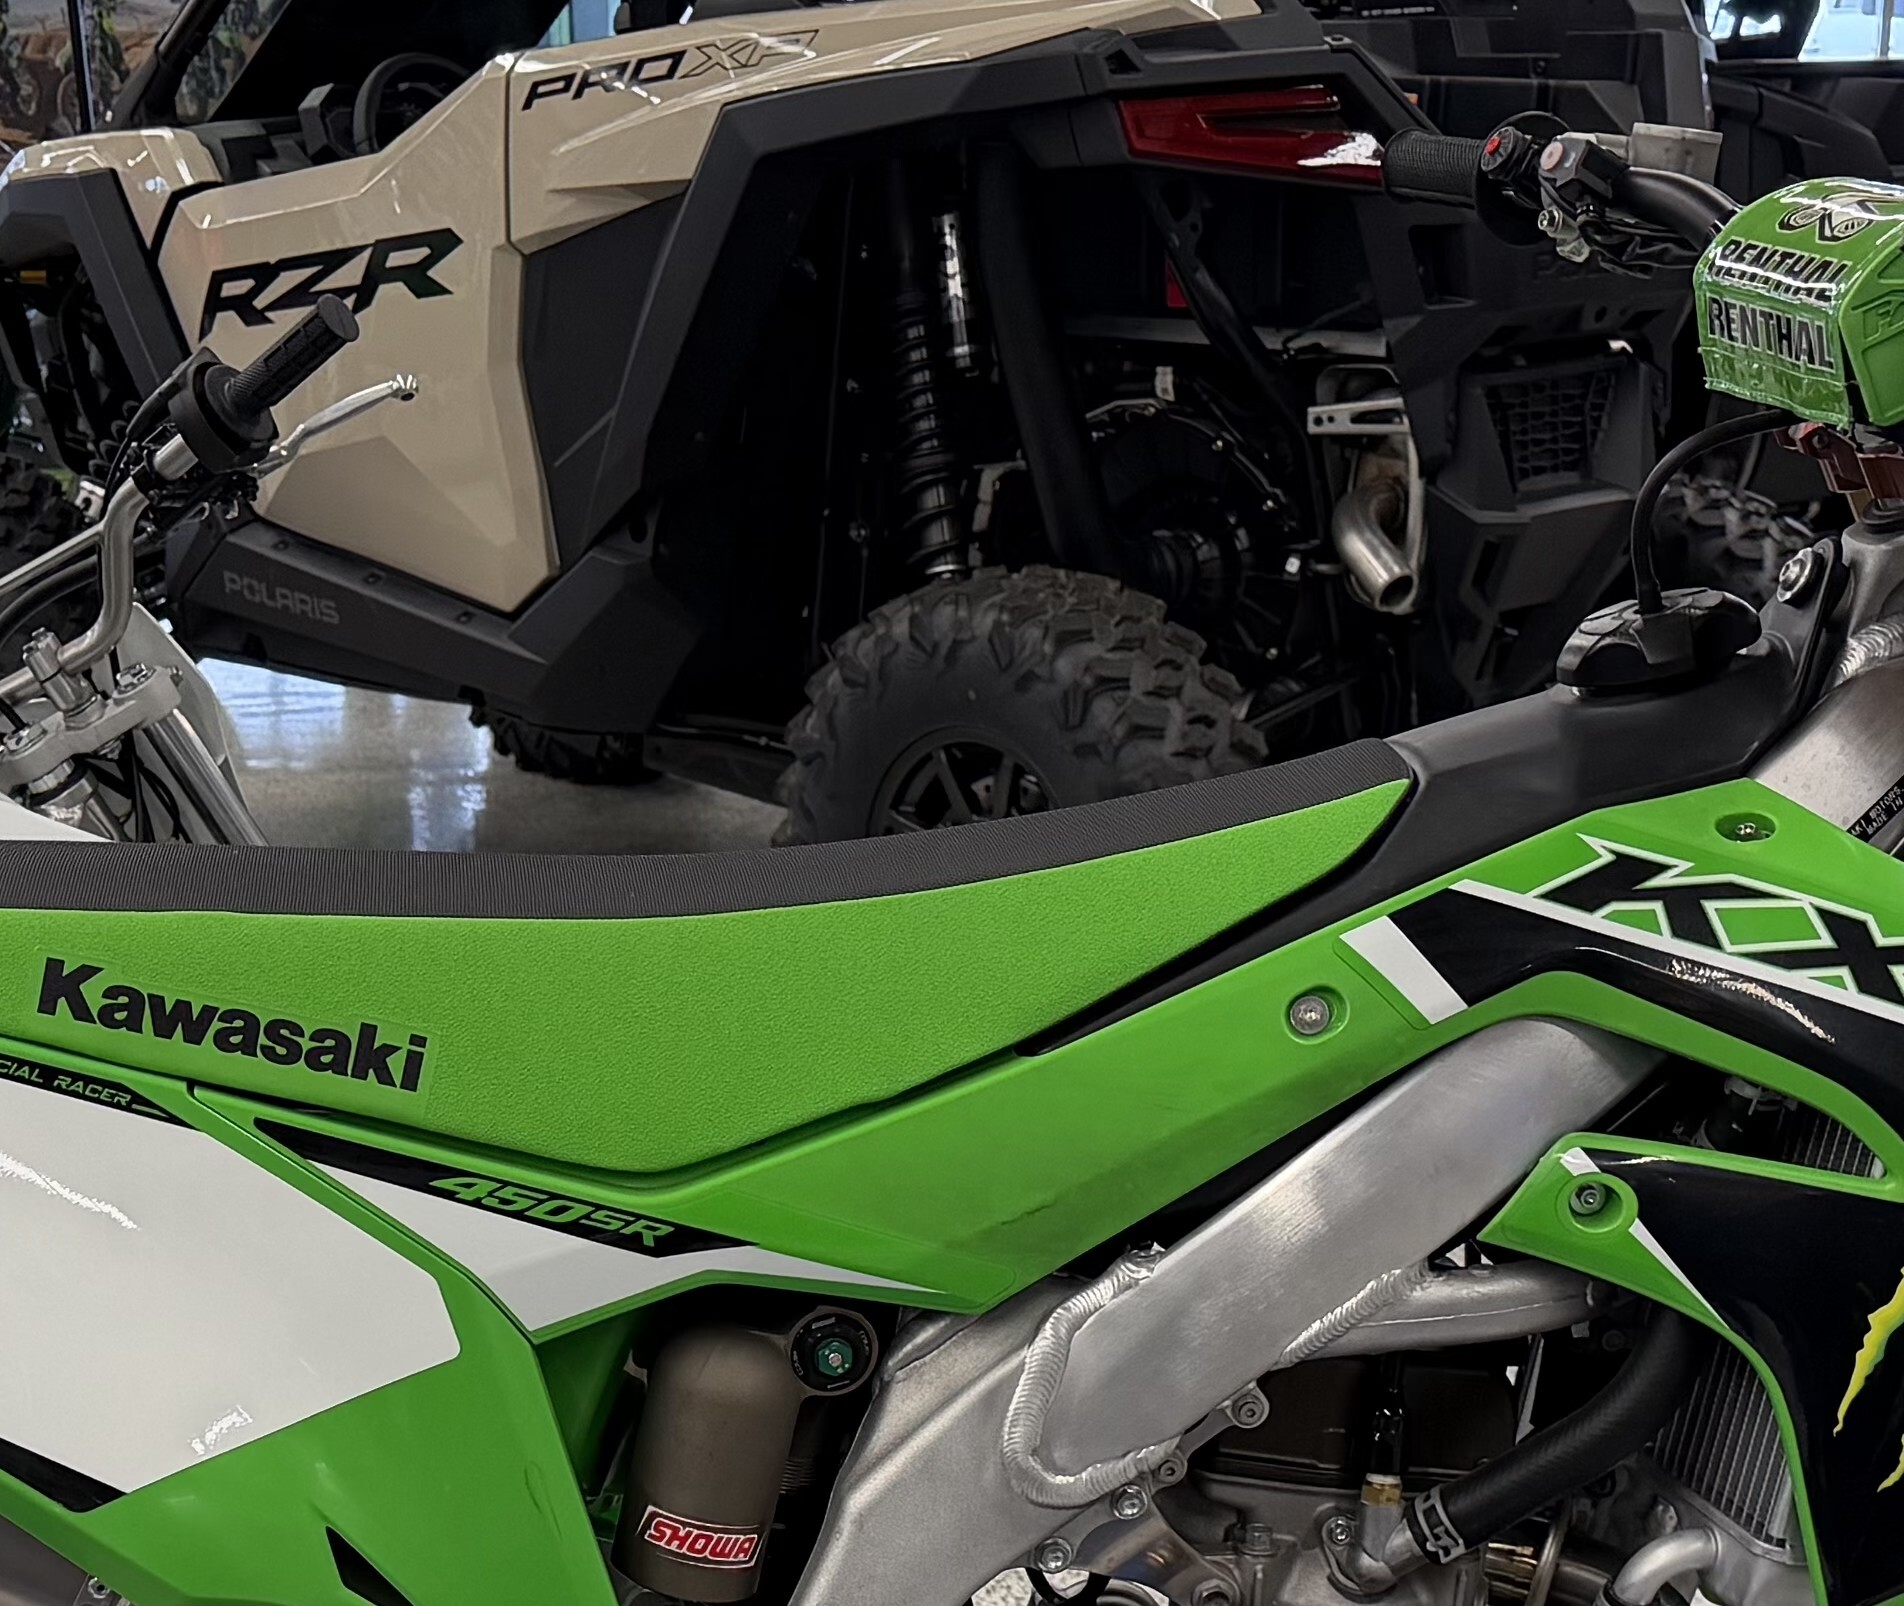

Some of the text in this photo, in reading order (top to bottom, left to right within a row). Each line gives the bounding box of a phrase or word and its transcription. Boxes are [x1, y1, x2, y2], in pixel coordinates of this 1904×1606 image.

[198, 227, 464, 344] RZR
[1706, 292, 1837, 374] RENTHAL
[223, 570, 340, 625] POLARIS
[1867, 813, 1889, 836] MADE
[1891, 797, 1904, 811] IN
[37, 957, 428, 1092] Kawasaki
[53, 1075, 131, 1106] RACER
[429, 1177, 675, 1247] 450SR
[644, 1518, 757, 1561] SHOWA
